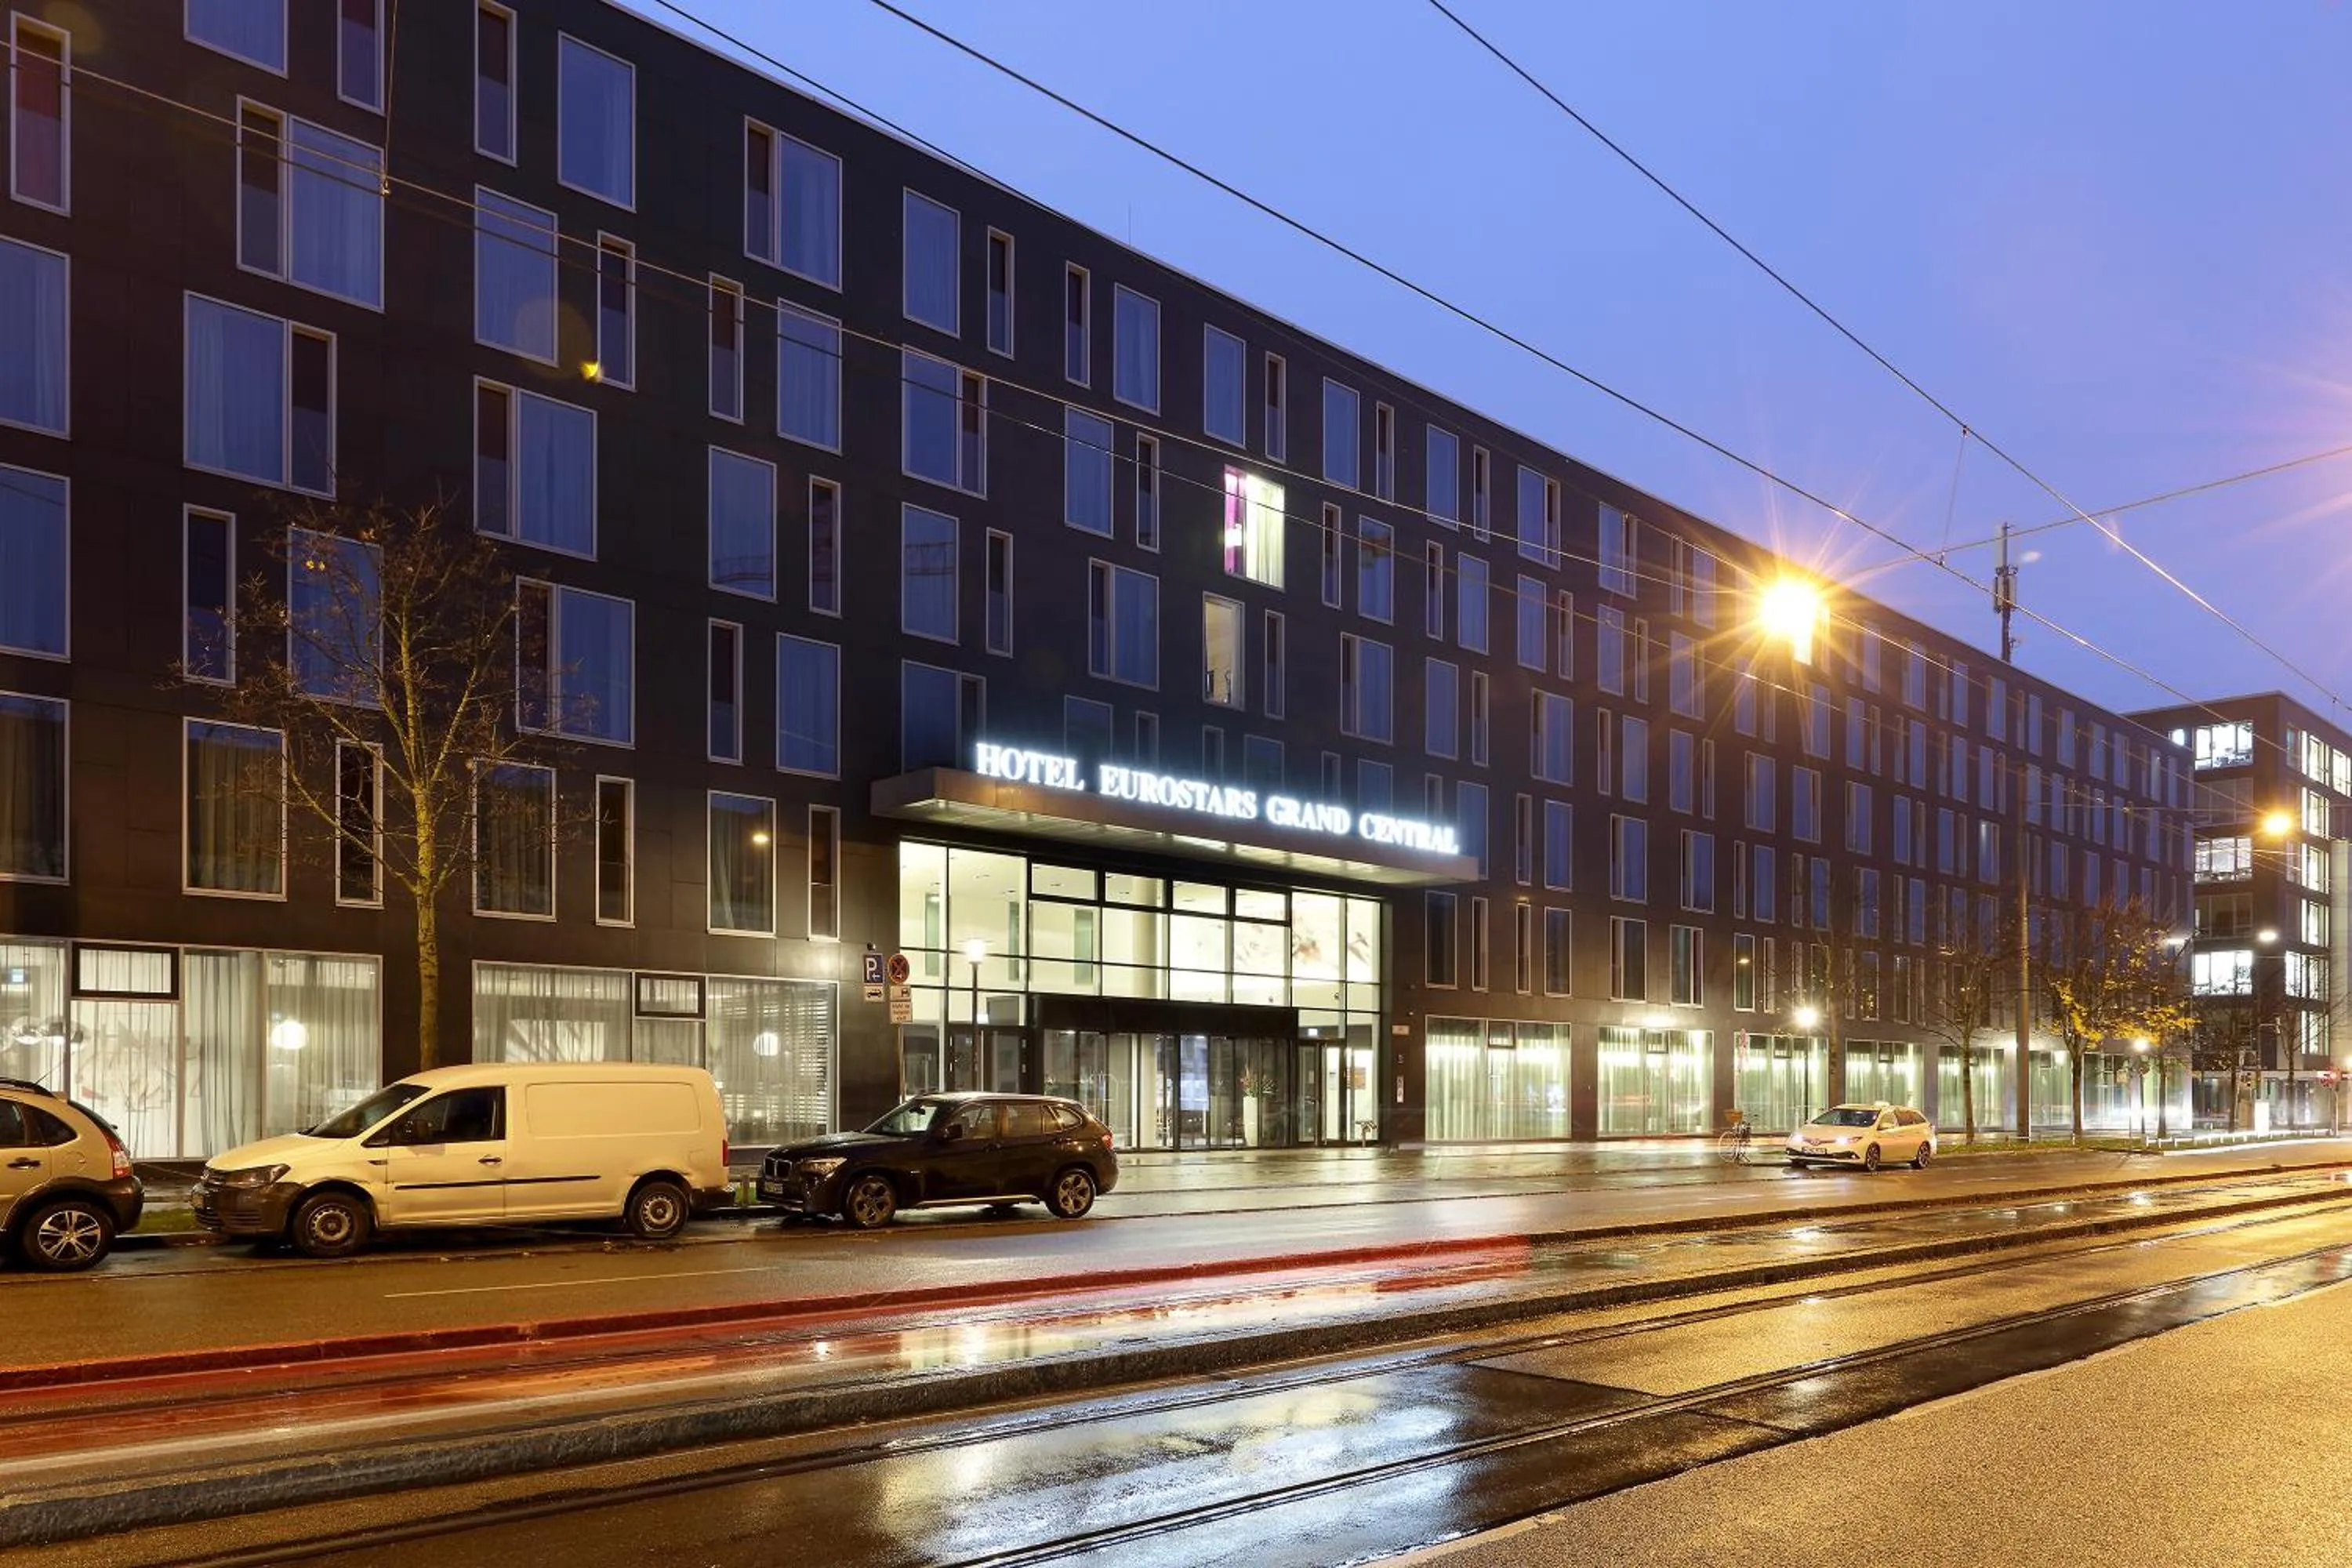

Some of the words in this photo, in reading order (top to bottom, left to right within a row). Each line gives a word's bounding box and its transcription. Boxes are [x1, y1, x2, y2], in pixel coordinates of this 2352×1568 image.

[975, 742, 1084, 791] HOTEL
[1099, 764, 1258, 819] EUROSTARS
[1265, 795, 1351, 835] GRAND
[1359, 812, 1459, 855] CENTRAL
[866, 957, 877, 981] P
